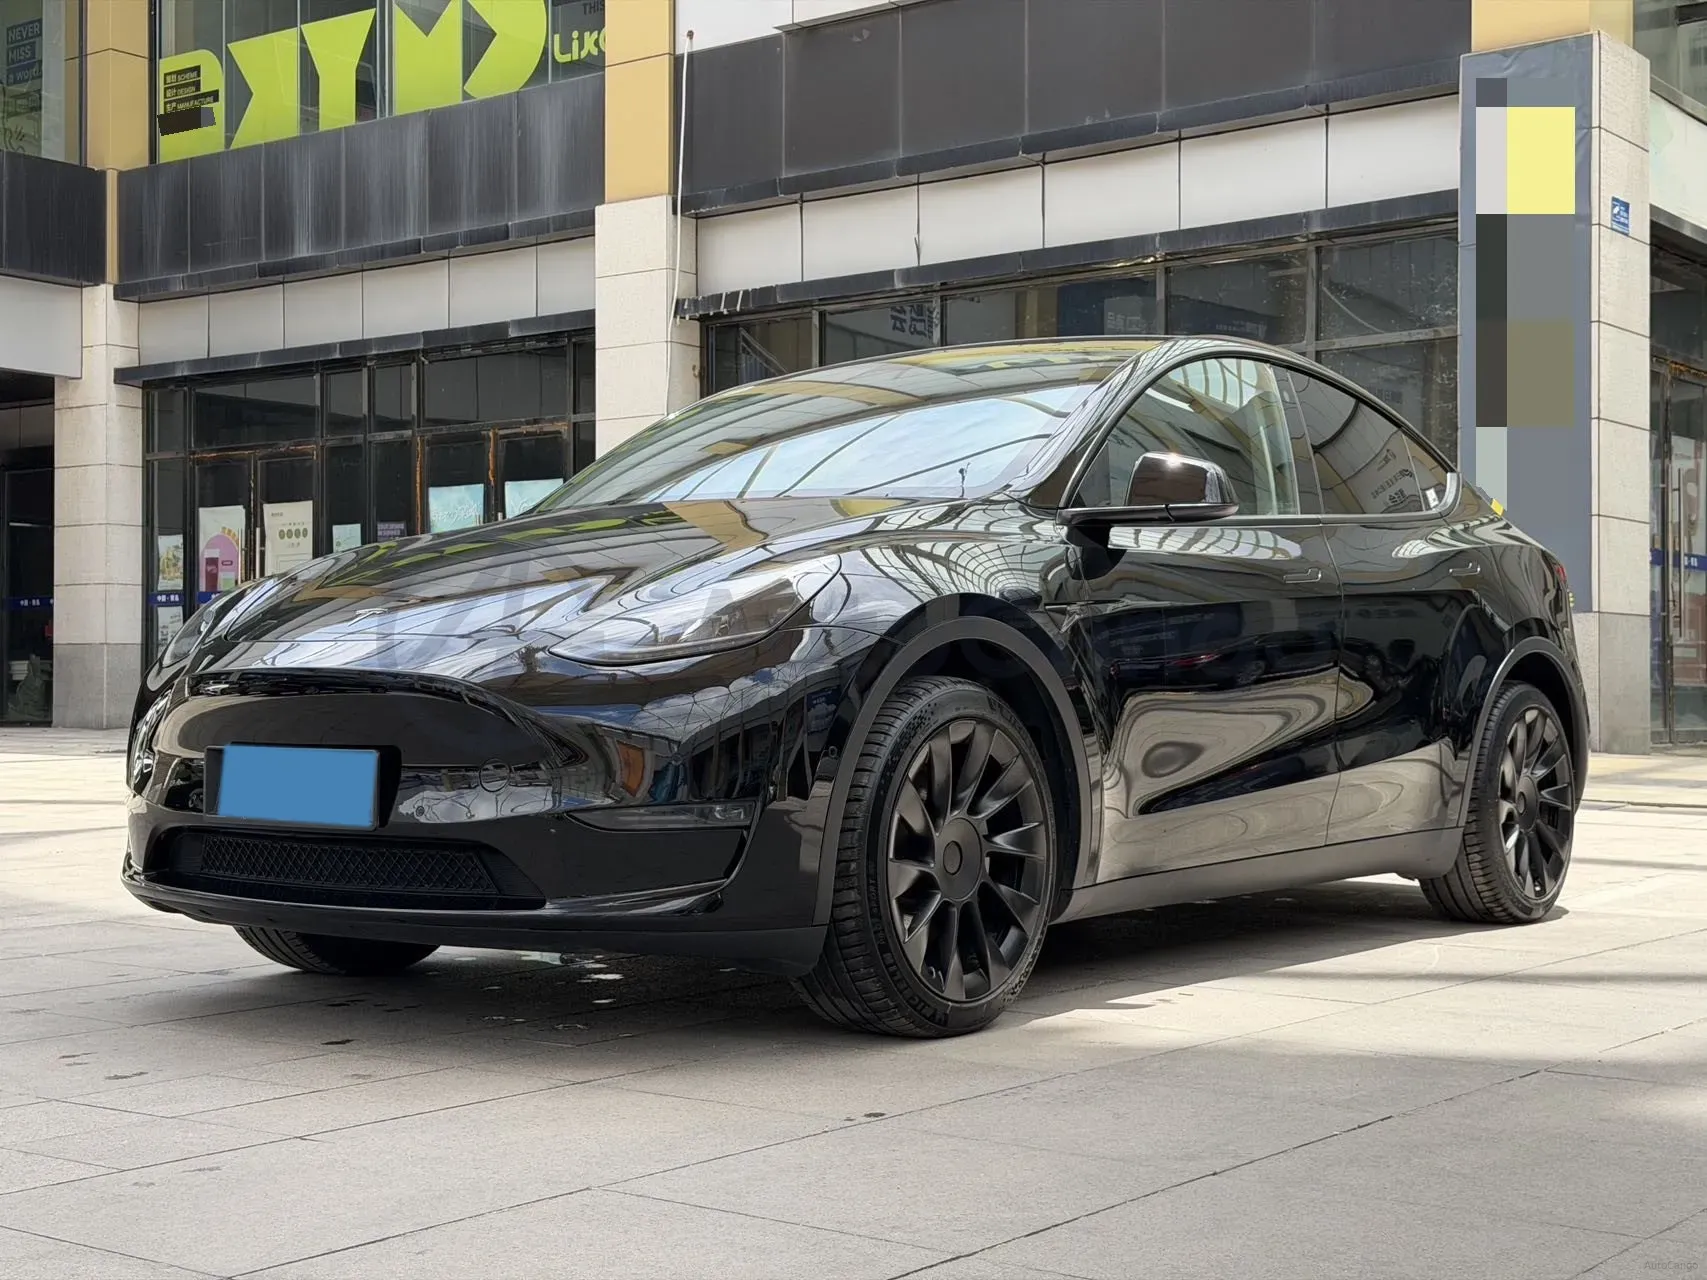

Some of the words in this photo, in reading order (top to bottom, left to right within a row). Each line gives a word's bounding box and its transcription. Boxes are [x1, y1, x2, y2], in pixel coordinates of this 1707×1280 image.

[8, 22, 40, 41] NEVER
[8, 44, 31, 63] MISS
[177, 70, 198, 82] SCHEME
[177, 86, 196, 96] DESIGN
[177, 96, 214, 109] MANUFACTURE
